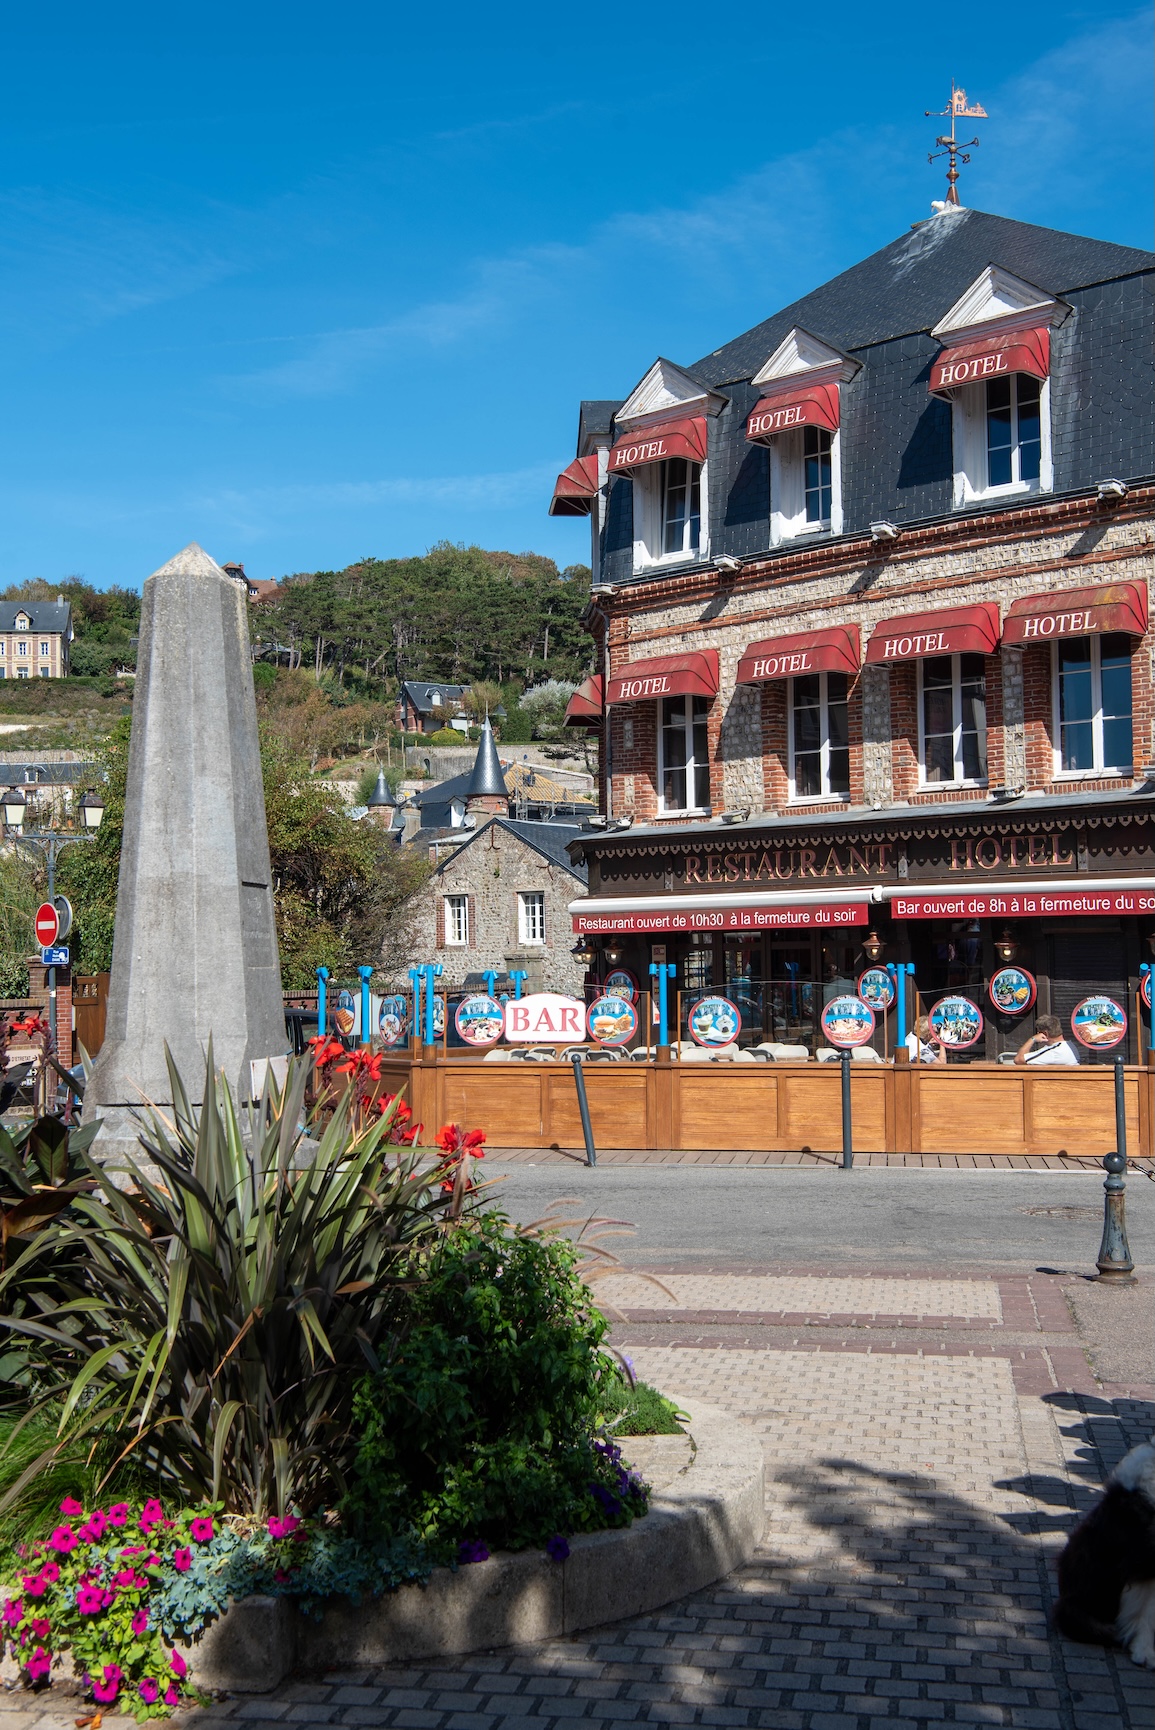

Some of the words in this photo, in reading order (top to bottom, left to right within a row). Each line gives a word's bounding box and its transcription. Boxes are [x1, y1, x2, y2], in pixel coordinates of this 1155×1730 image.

[939, 353, 1008, 385] HOTEL
[748, 406, 806, 435] HOTEL
[614, 440, 667, 466] HOTEL
[1023, 611, 1097, 638] HOTEL
[883, 633, 950, 658] HOTEL
[752, 653, 812, 678] HOTEL
[619, 676, 671, 698] HOTEL
[683, 844, 892, 884] RESTAURANT
[948, 834, 1073, 870] HOTEL
[897, 900, 920, 914] Bar
[923, 900, 965, 913] ouvert
[968, 898, 985, 912] de
[989, 898, 1006, 912] 8h
[1010, 897, 1020, 911] à
[1023, 897, 1036, 911] la
[1040, 896, 1111, 911] fermeture
[1115, 895, 1134, 910] du
[578, 916, 634, 930] Restaurant
[637, 915, 670, 928] ouvert
[672, 914, 686, 927] de
[690, 913, 724, 926] 10h30
[730, 911, 738, 925] à
[741, 911, 751, 925] la
[754, 910, 810, 924] fermeture
[815, 909, 831, 923] du
[833, 909, 857, 922] soir
[510, 1007, 582, 1032] BAR
